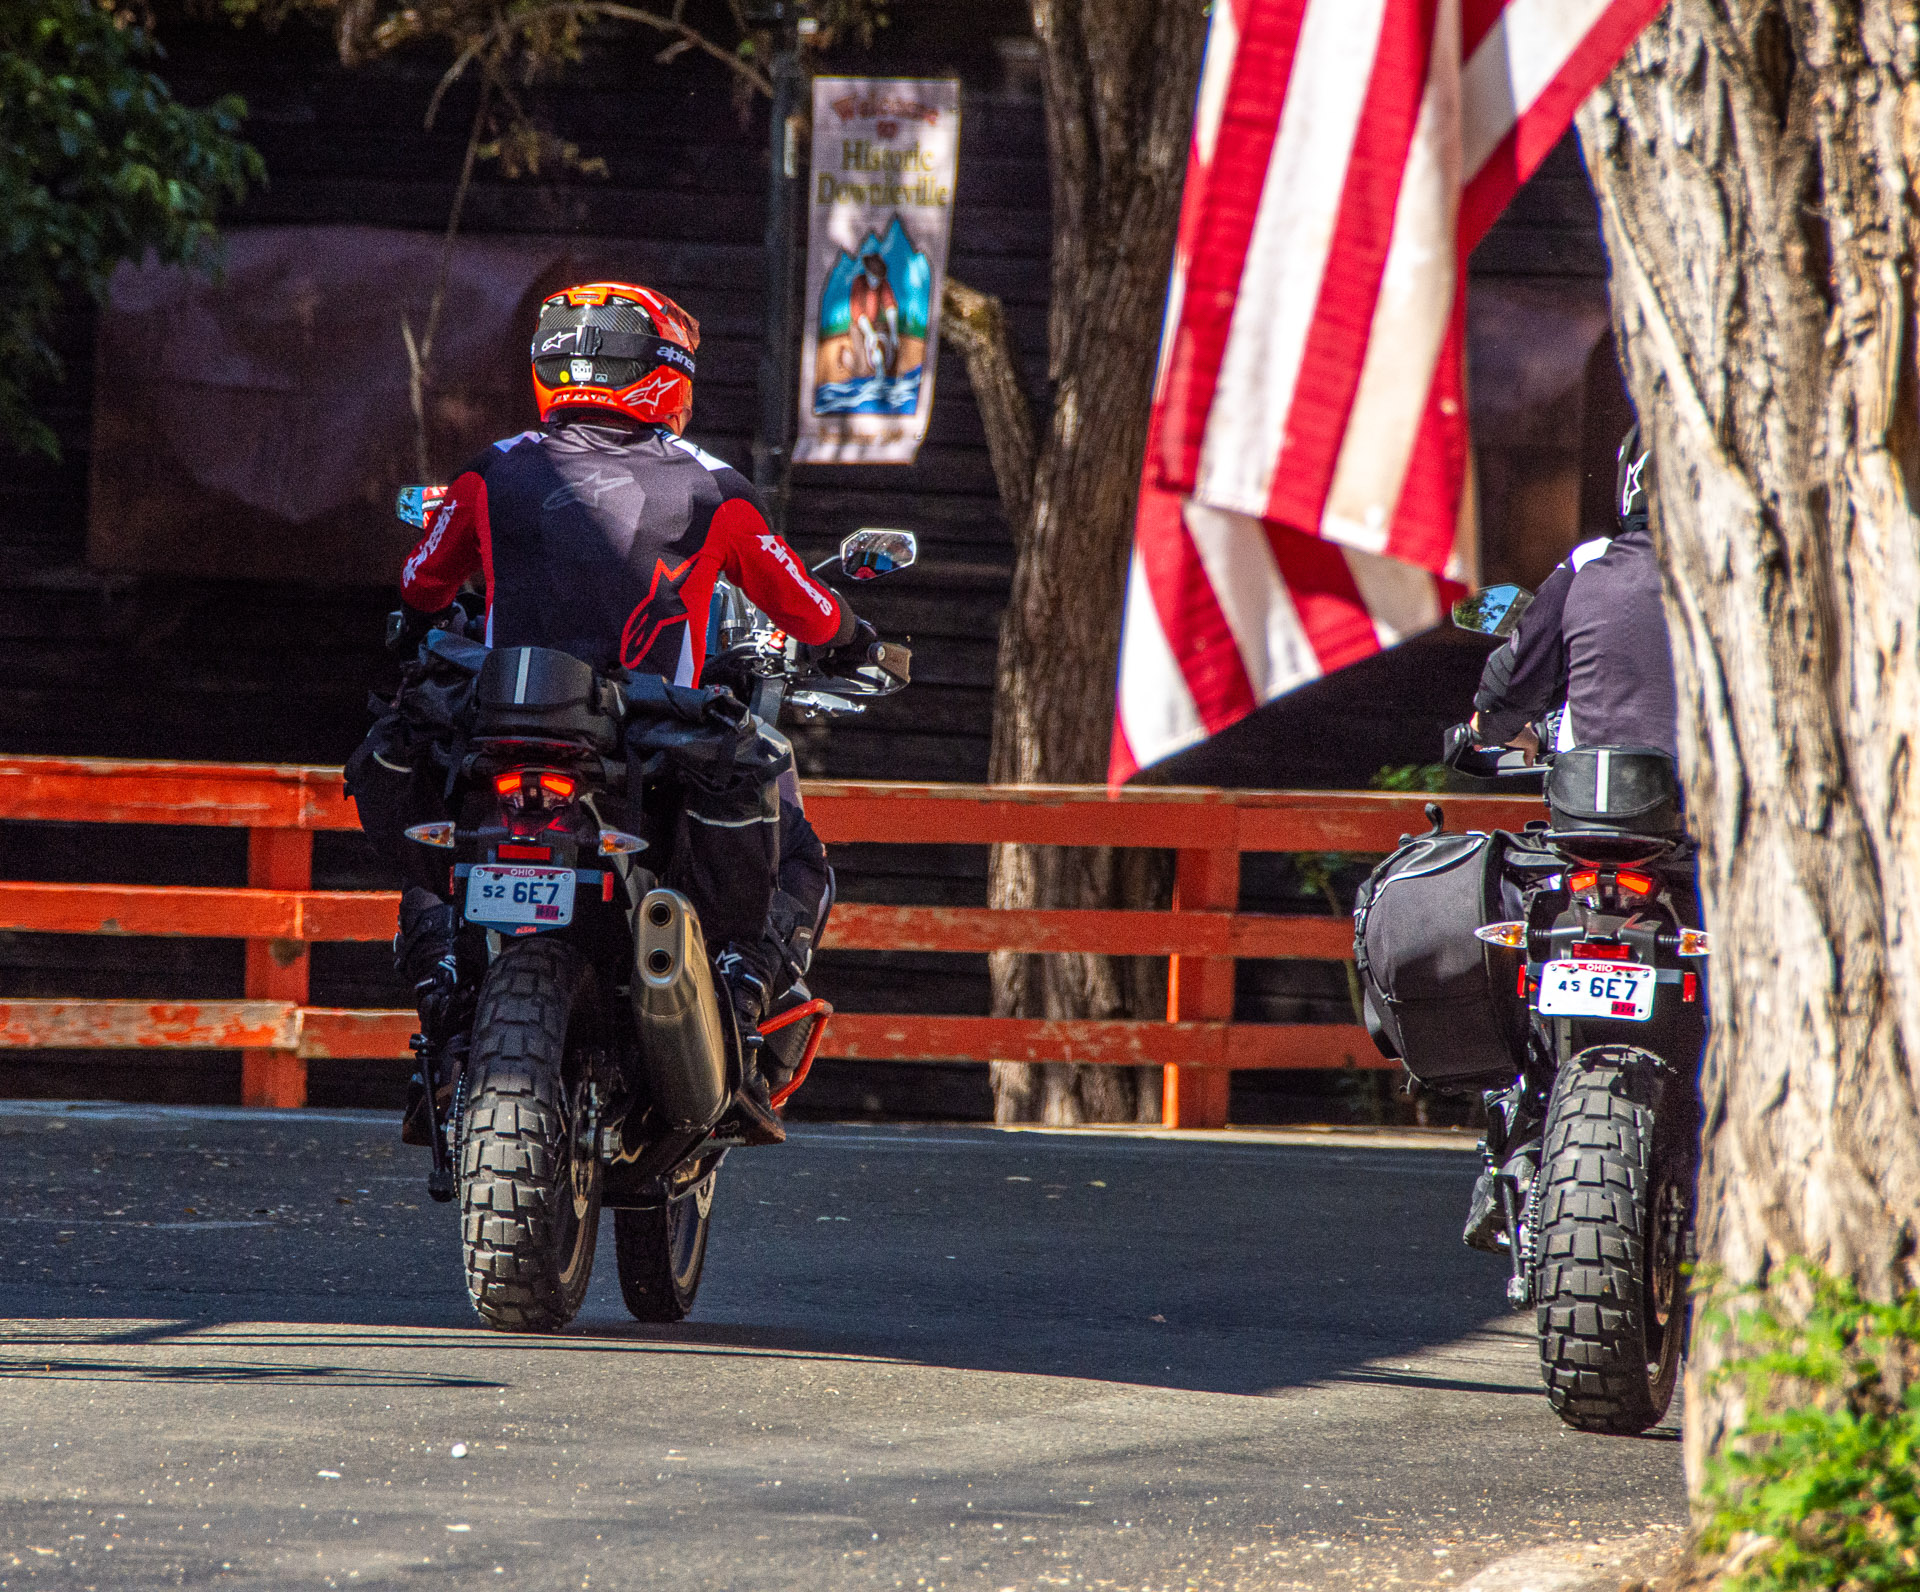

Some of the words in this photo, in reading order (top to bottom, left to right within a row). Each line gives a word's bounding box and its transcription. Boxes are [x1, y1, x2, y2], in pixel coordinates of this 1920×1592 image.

[842, 138, 935, 172] Historic
[510, 868, 536, 876] OHIO
[482, 885, 506, 898] 52
[512, 881, 560, 905] 6E7
[1586, 963, 1614, 972] OHIO
[1589, 977, 1638, 1001] 6E7
